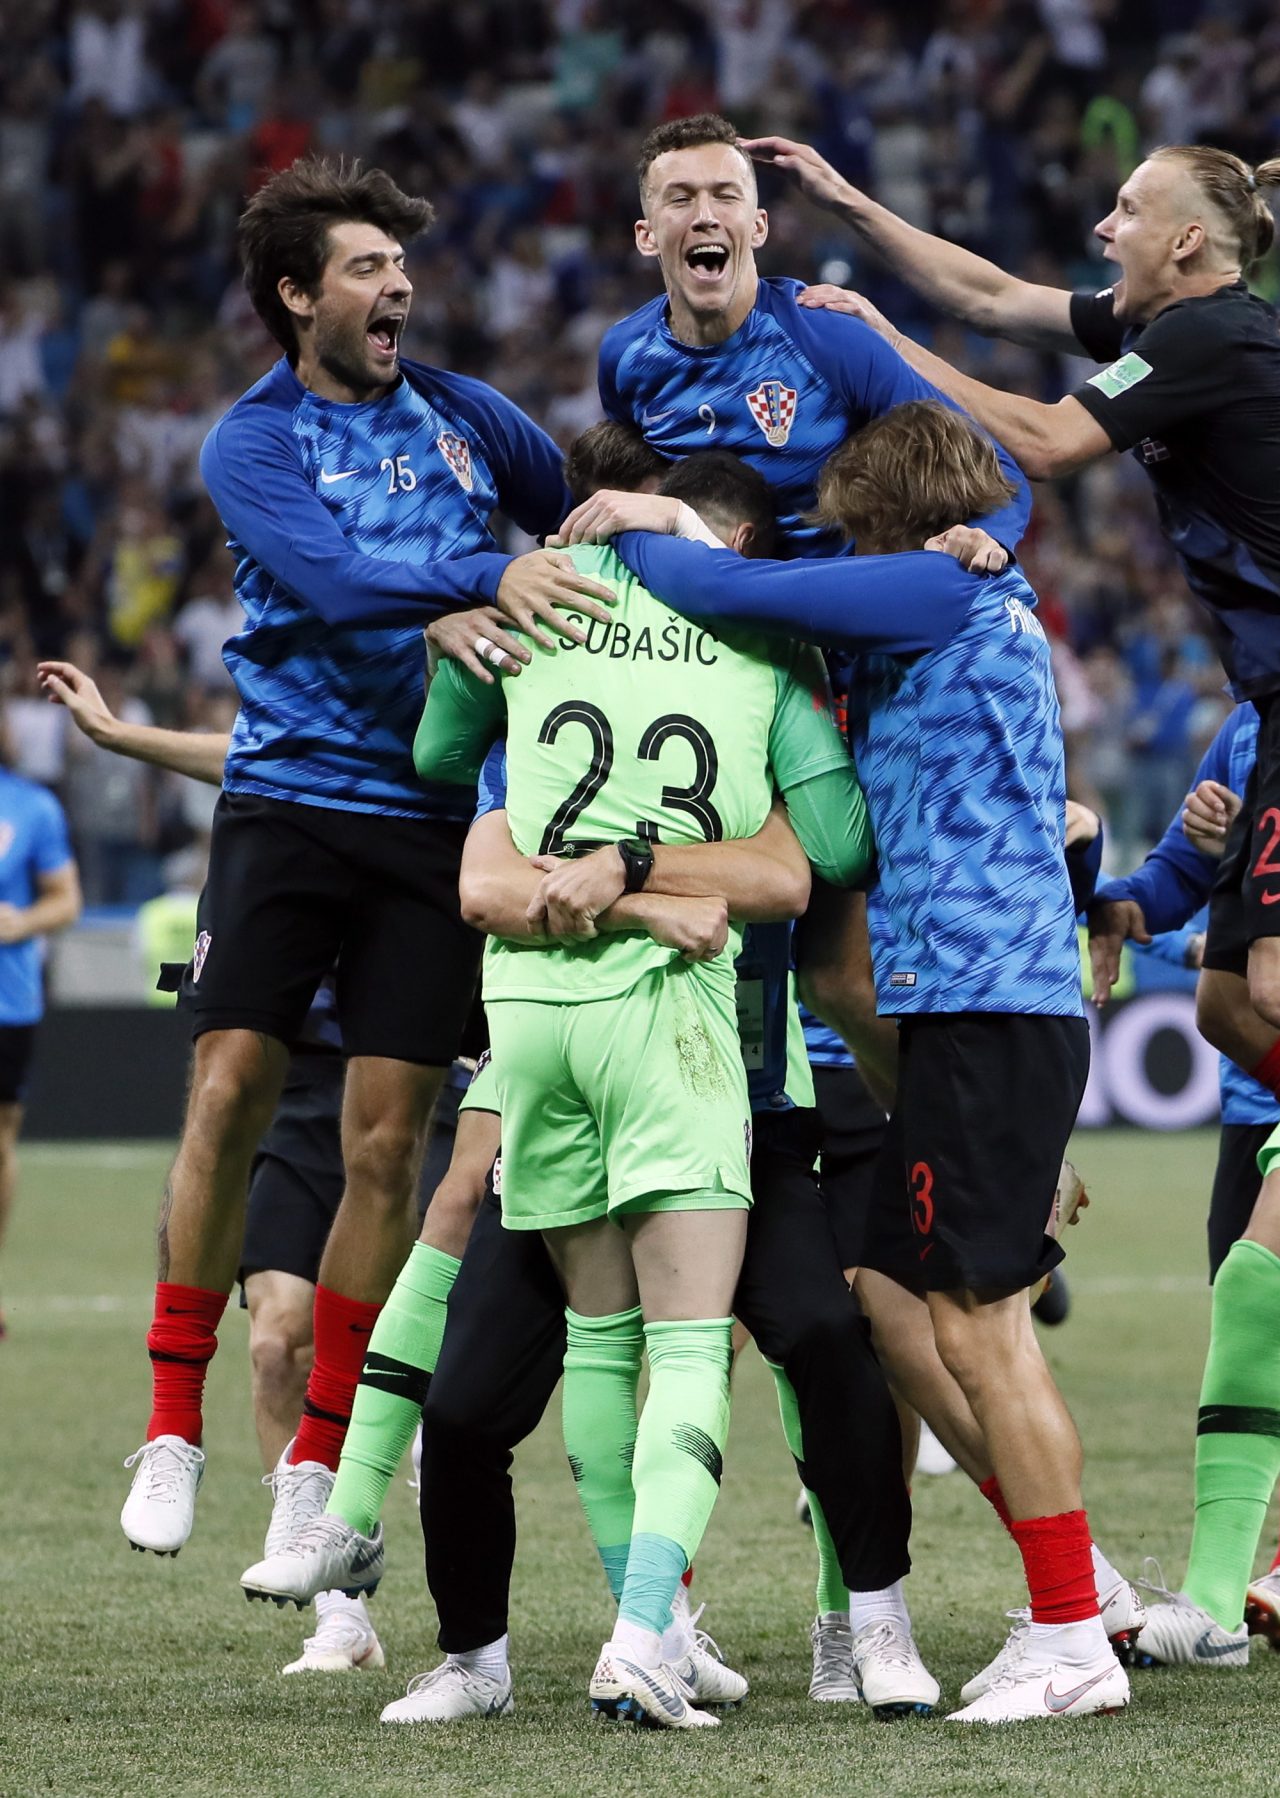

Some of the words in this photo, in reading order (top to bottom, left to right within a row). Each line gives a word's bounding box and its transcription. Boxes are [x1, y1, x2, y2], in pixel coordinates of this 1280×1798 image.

[698, 404, 716, 435] 9
[380, 454, 417, 494] 25
[537, 700, 724, 857] 23
